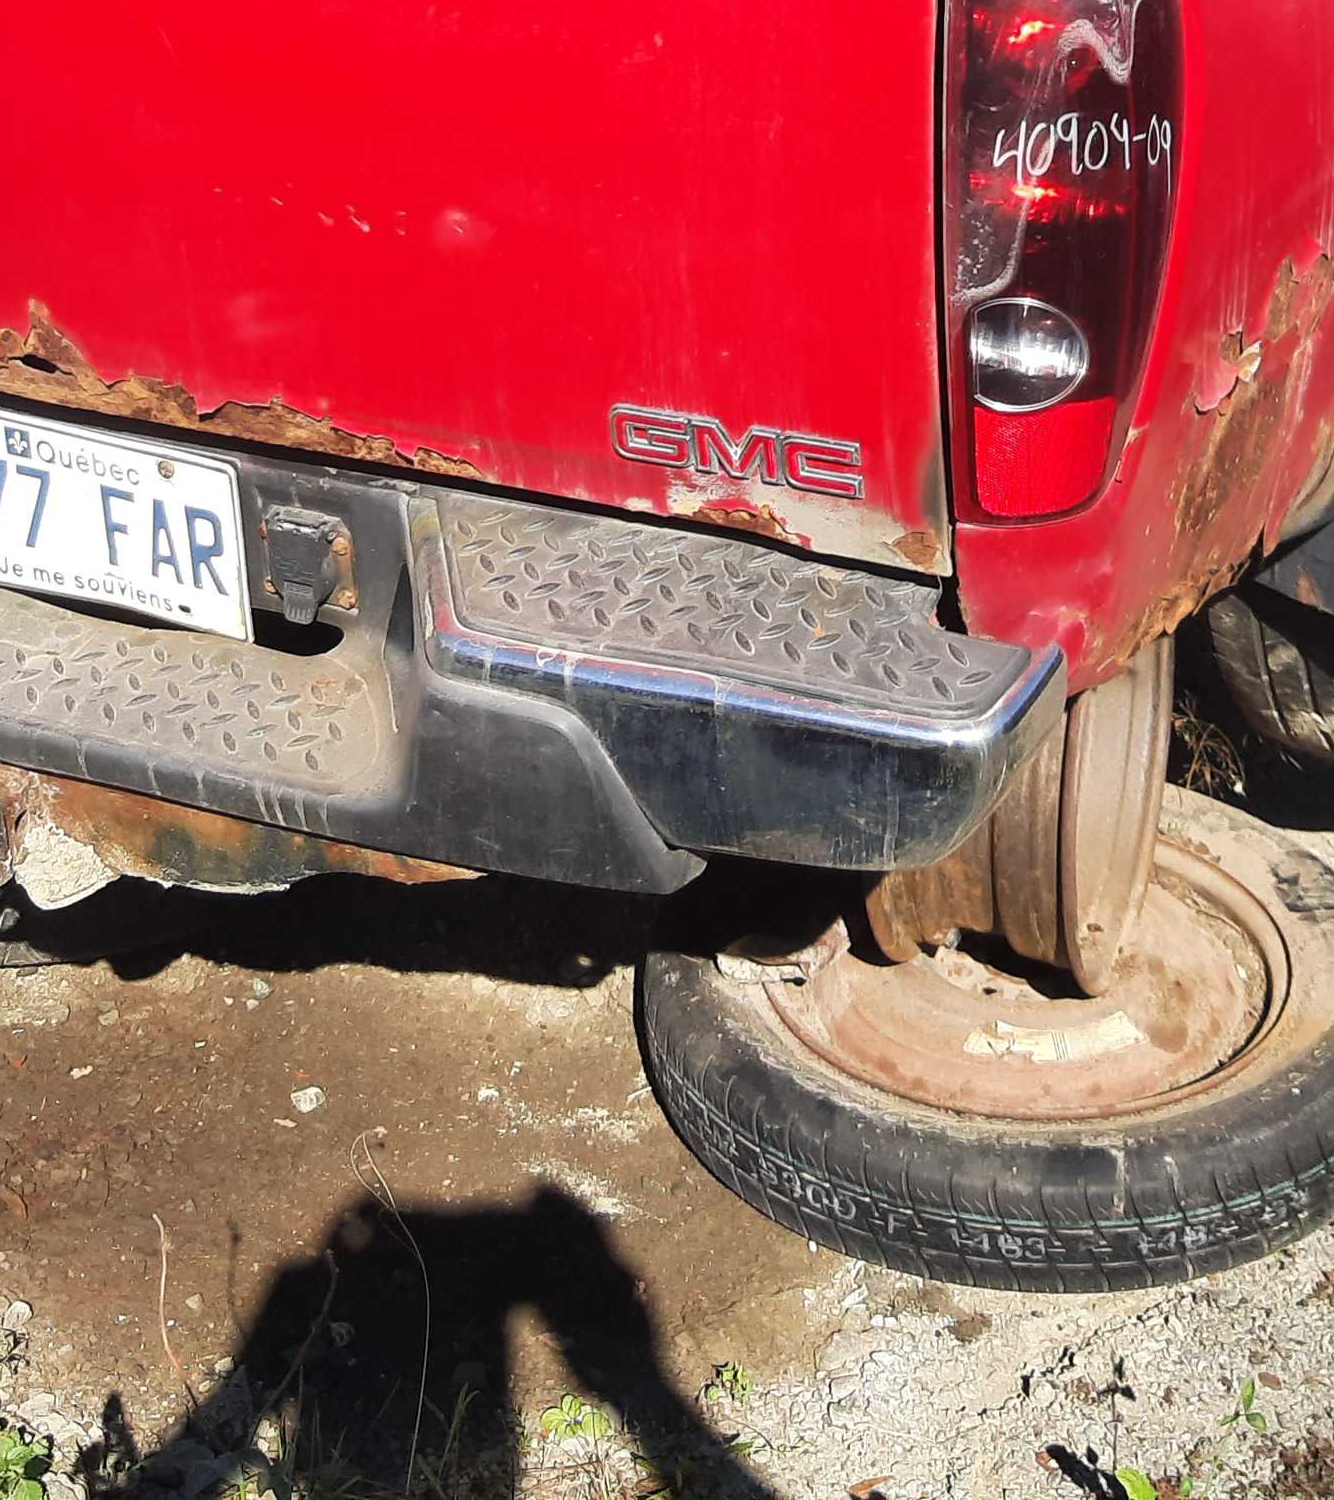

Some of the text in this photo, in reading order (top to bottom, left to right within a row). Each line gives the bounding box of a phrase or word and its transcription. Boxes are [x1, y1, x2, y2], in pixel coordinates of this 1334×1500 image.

[992, 111, 1173, 197] 40904-09
[36, 440, 140, 486] Québec
[609, 402, 864, 500] GMC
[99, 483, 229, 596] FAR
[33, 569, 65, 586] me
[74, 573, 174, 613] souviens
